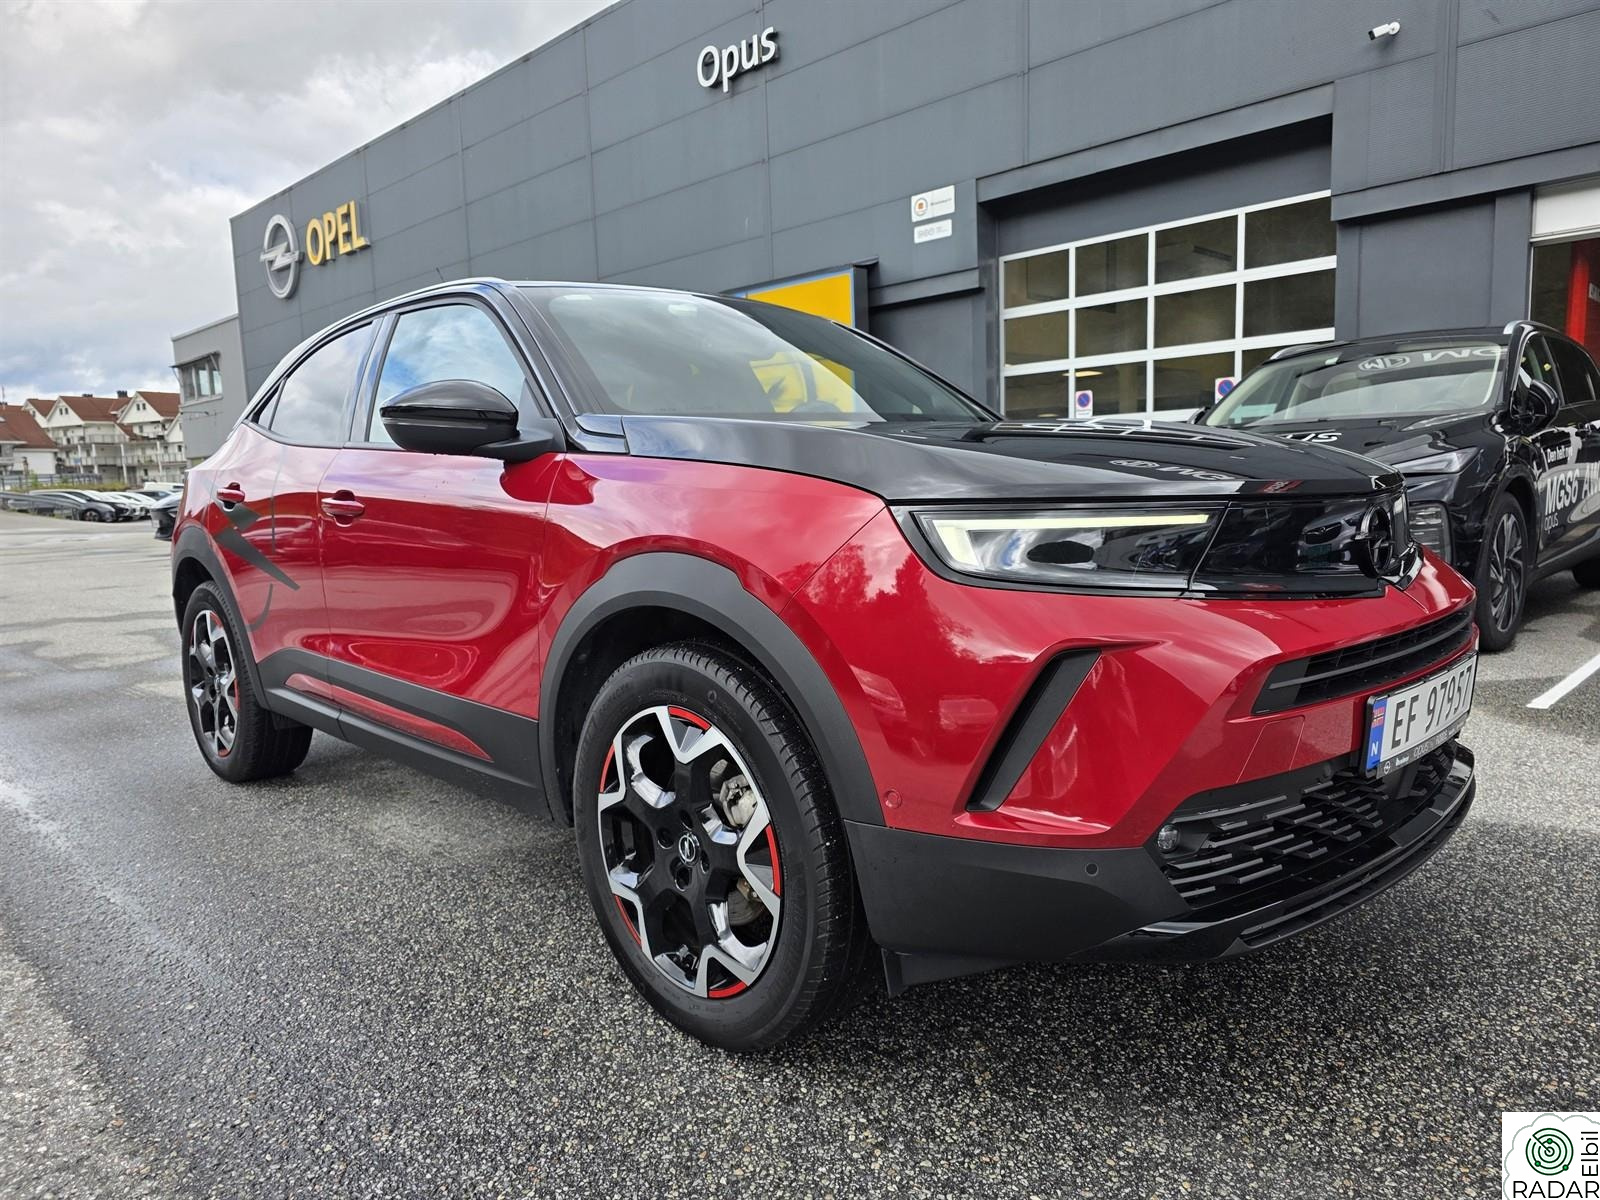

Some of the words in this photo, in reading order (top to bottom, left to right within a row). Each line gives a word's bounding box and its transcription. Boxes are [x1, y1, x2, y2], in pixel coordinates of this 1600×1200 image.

[697, 26, 776, 93] Opus
[306, 200, 367, 266] OPEL
[1545, 469, 1580, 516] MGS6
[1391, 695, 1420, 750] EF
[1425, 664, 1473, 733] 97957
[1371, 741, 1379, 757] N
